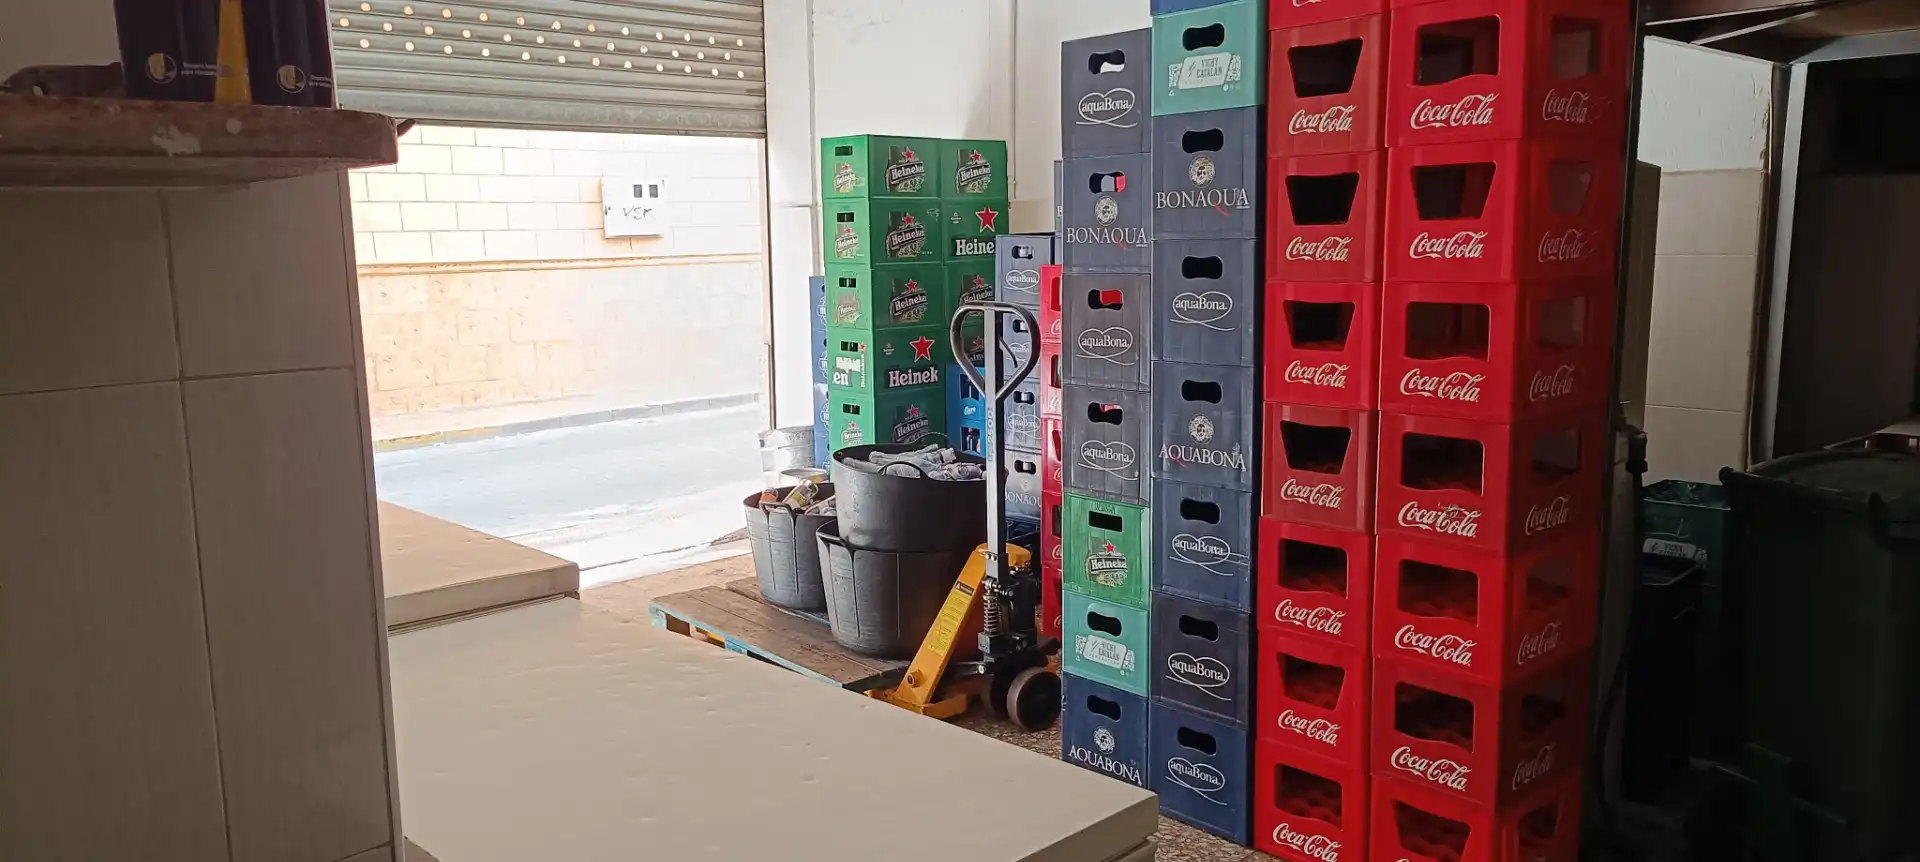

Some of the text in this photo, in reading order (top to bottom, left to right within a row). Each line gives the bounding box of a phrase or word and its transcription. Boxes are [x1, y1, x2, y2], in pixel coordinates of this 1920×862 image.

[1289, 105, 1356, 134] Coca-Cola
[1411, 94, 1498, 129] Coca-Cola
[1156, 187, 1250, 216] BONAQUA
[955, 238, 996, 256] Heine
[1066, 227, 1148, 249] BONAQUA
[1286, 237, 1352, 261] Coca-Cola
[1410, 232, 1487, 258] Coca-Cola
[1285, 360, 1349, 387] Coca-Cola
[1400, 369, 1486, 402] Coca-Cola
[1158, 443, 1247, 472] AQUABONA
[1281, 479, 1344, 508] Coca-Cola
[1398, 502, 1481, 537] Coca-Cola
[1275, 599, 1346, 634] Coca-Cola
[1395, 625, 1476, 665] Coca-Cola
[1278, 710, 1340, 746] Coca-Cola
[1068, 745, 1142, 786] AQUABONA
[1391, 747, 1471, 791] Coca-Cola
[1273, 823, 1341, 862] Coca-Cola
